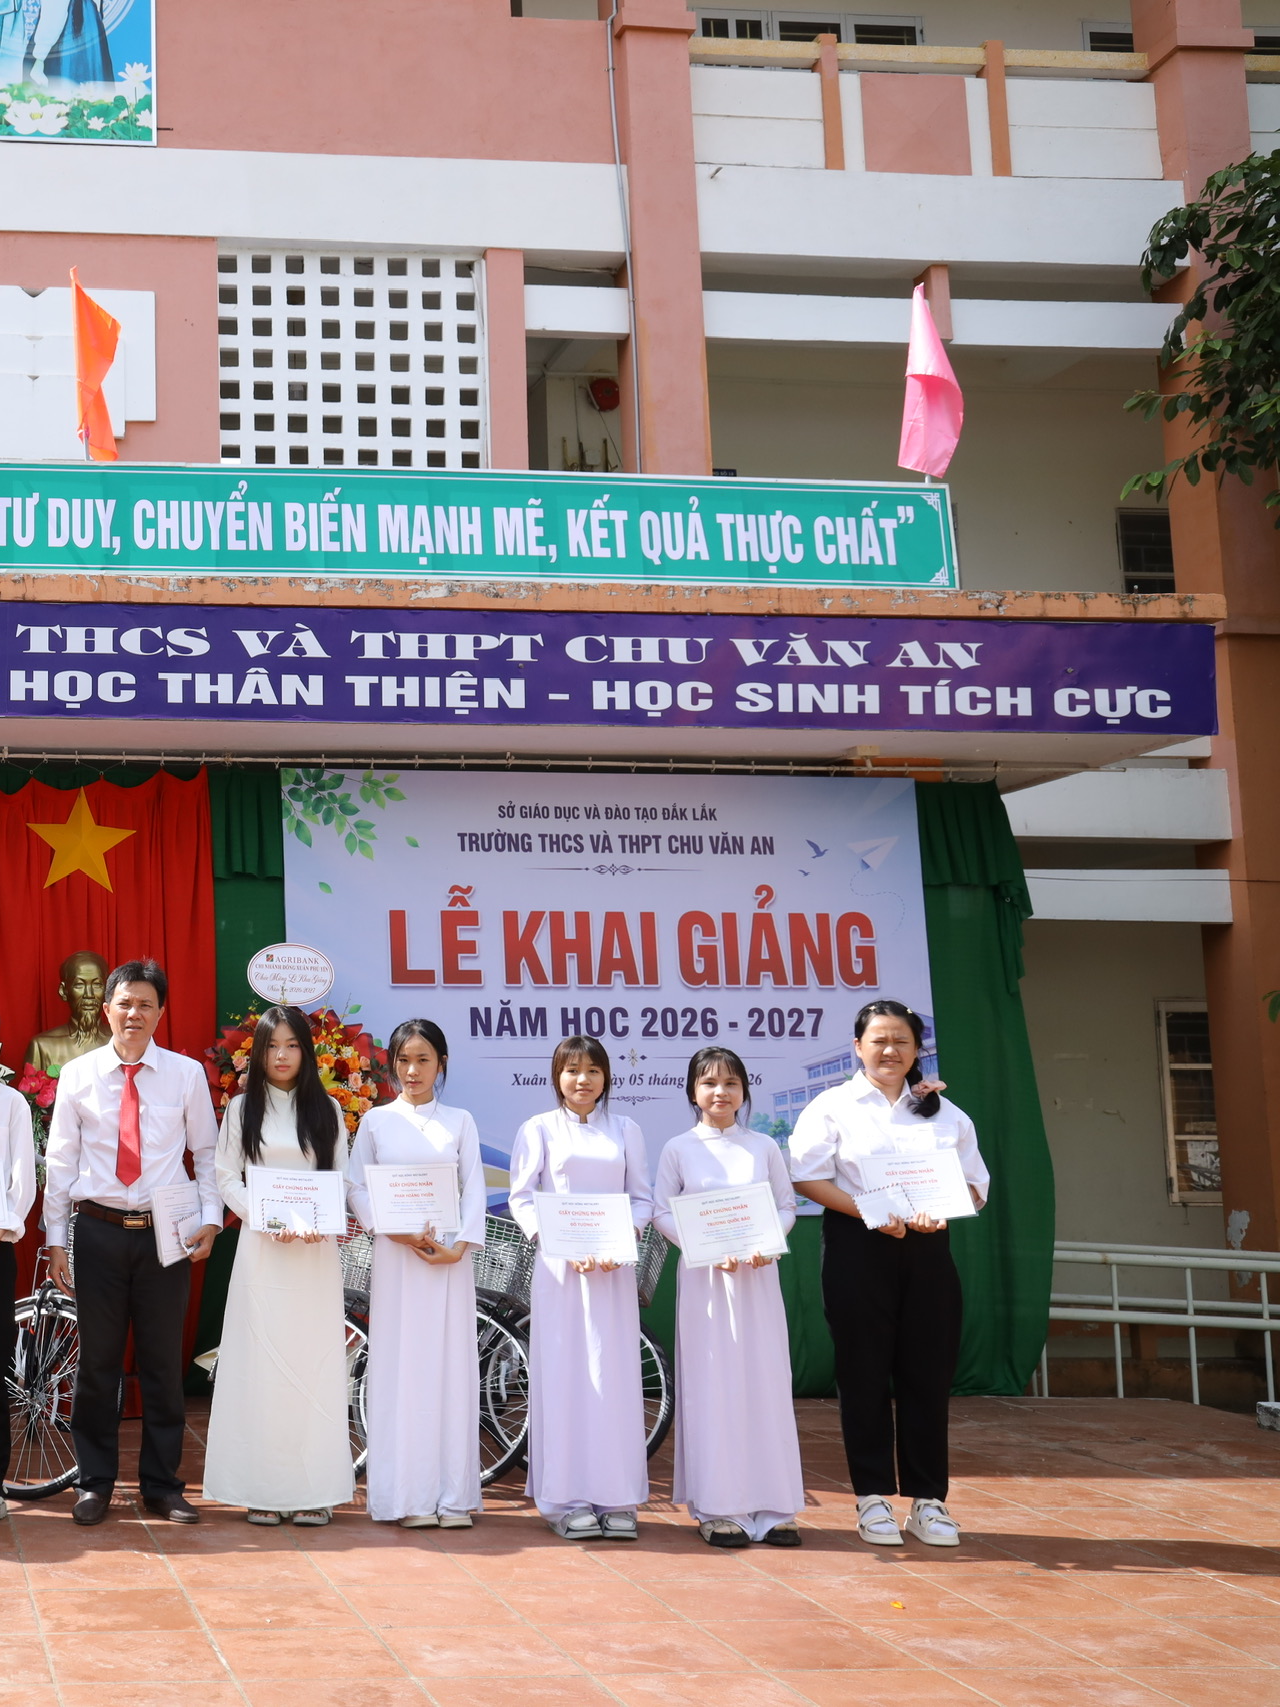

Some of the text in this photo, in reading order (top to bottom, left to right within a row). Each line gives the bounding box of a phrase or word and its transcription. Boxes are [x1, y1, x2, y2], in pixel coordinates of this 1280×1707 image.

[47, 497, 121, 555] DUY,
[133, 480, 273, 551] CHUYỂN
[284, 487, 367, 553] BIẾN
[377, 504, 483, 566] MẠNH
[493, 497, 557, 563] MẼ,
[566, 494, 628, 559] KẾT
[639, 495, 710, 565] QUẢ
[715, 510, 804, 574] THỰC
[15, 623, 211, 658] THCS
[231, 622, 332, 658] VÀ
[350, 630, 544, 662] THPT
[565, 634, 714, 665] CHU
[729, 632, 871, 668] VĂN
[885, 640, 983, 670] AN
[9, 669, 136, 709] HỌC
[157, 667, 324, 706] THÂN
[344, 670, 526, 715] THIỆN
[592, 680, 713, 717] HỌC
[735, 682, 880, 714] SINH
[899, 679, 1033, 716] TÍCH
[1053, 686, 1172, 724] CỰC
[497, 800, 718, 822] SỞ GIÁO DỤC VÀ ĐÀO TẠO ĐẮK LẮK
[456, 828, 775, 856] TRƯỜNG THCS VÀ THPT CHU VĂN AN
[389, 884, 878, 987] LỄ KHAI GIẢNG
[275, 956, 319, 964] AGRIBANK
[469, 999, 548, 1037] NĂM
[640, 1007, 719, 1038] 2026
[728, 1021, 739, 1029] -
[747, 1007, 824, 1038] 2027
[511, 1073, 547, 1086] Xuân
[628, 1073, 645, 1086] 05
[648, 1073, 685, 1089] tháng
[713, 1206, 732, 1214] CHỨNG
